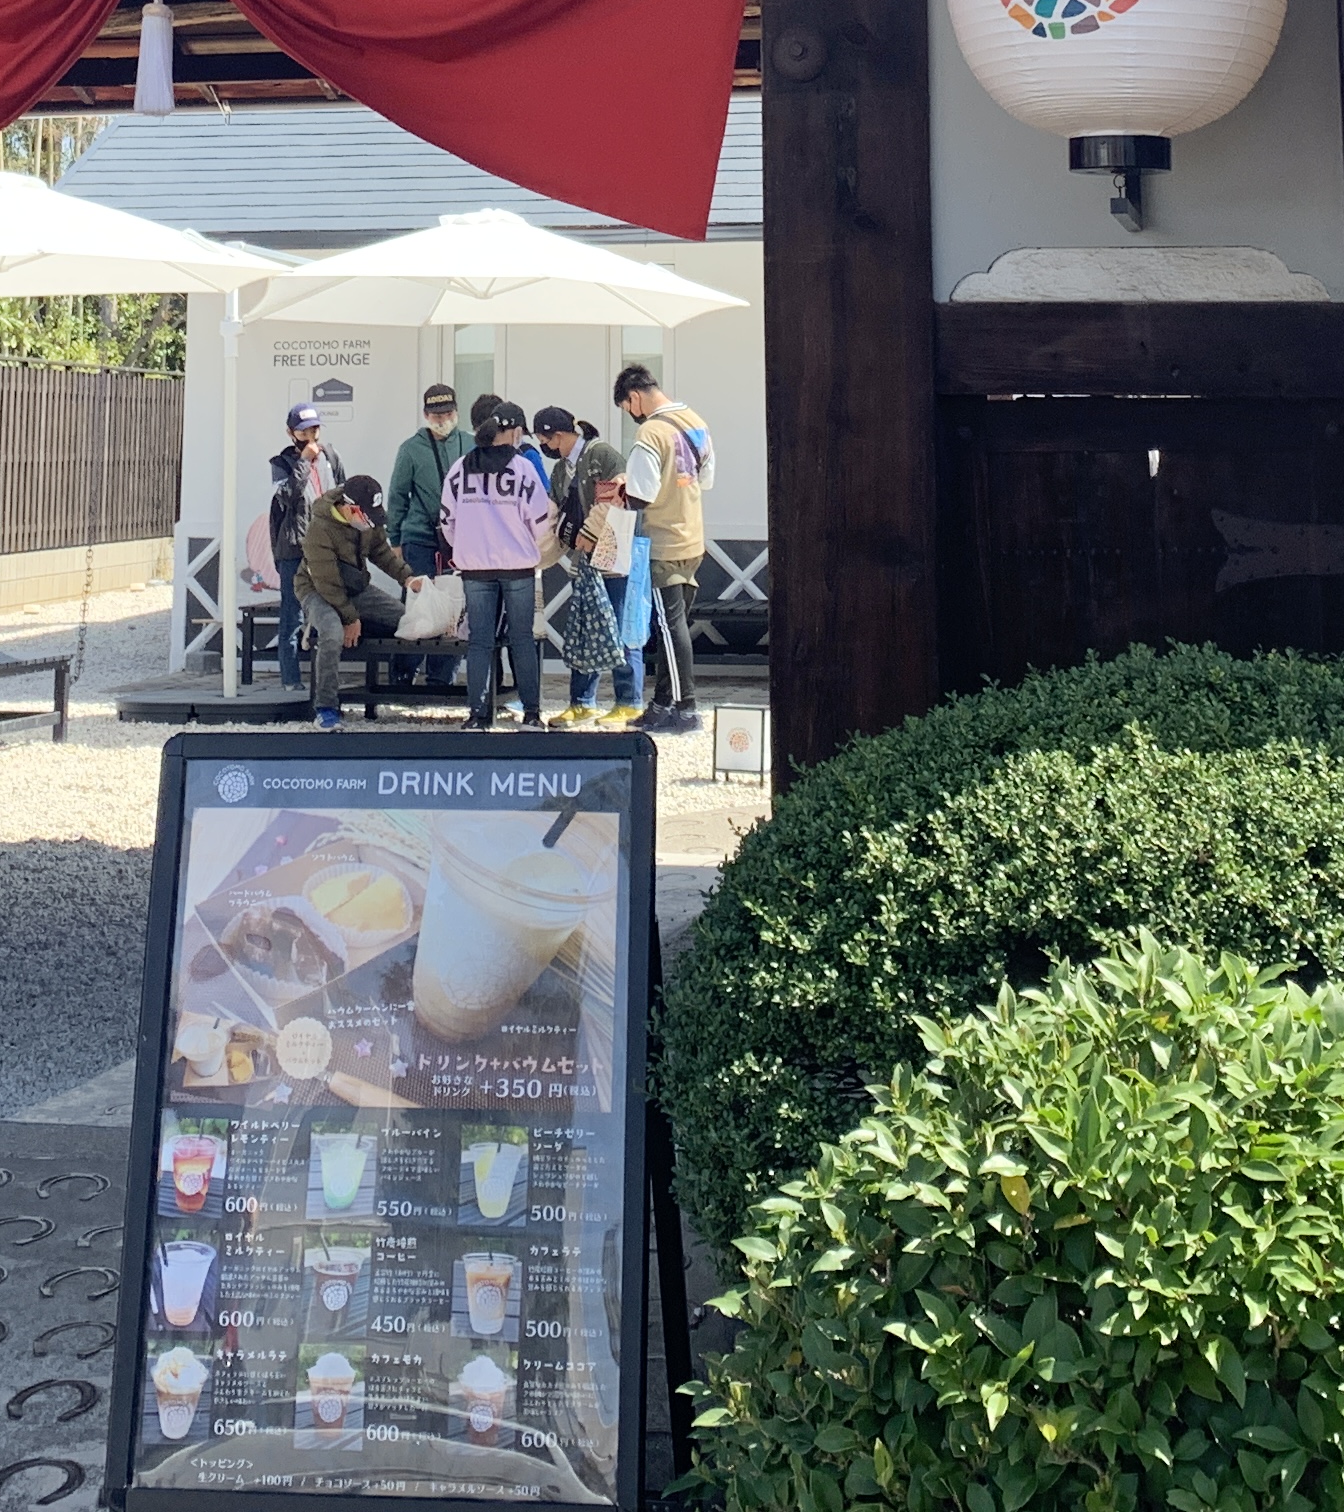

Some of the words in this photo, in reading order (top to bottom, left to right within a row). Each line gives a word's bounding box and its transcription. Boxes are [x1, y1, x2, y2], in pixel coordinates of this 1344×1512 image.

[274, 340, 339, 350] COCOTOMO
[343, 340, 371, 349] FARM
[273, 354, 305, 367] FREE
[310, 353, 371, 366] LOUNGE
[262, 778, 333, 790] COCOTOMO
[336, 779, 367, 790] FARM
[378, 771, 474, 796] DRINK
[490, 772, 582, 798] MENU
[377, 1252, 416, 1262] コーヒー
[530, 1245, 581, 1257] カフェラテ
[371, 1353, 422, 1365] カフェモカ
